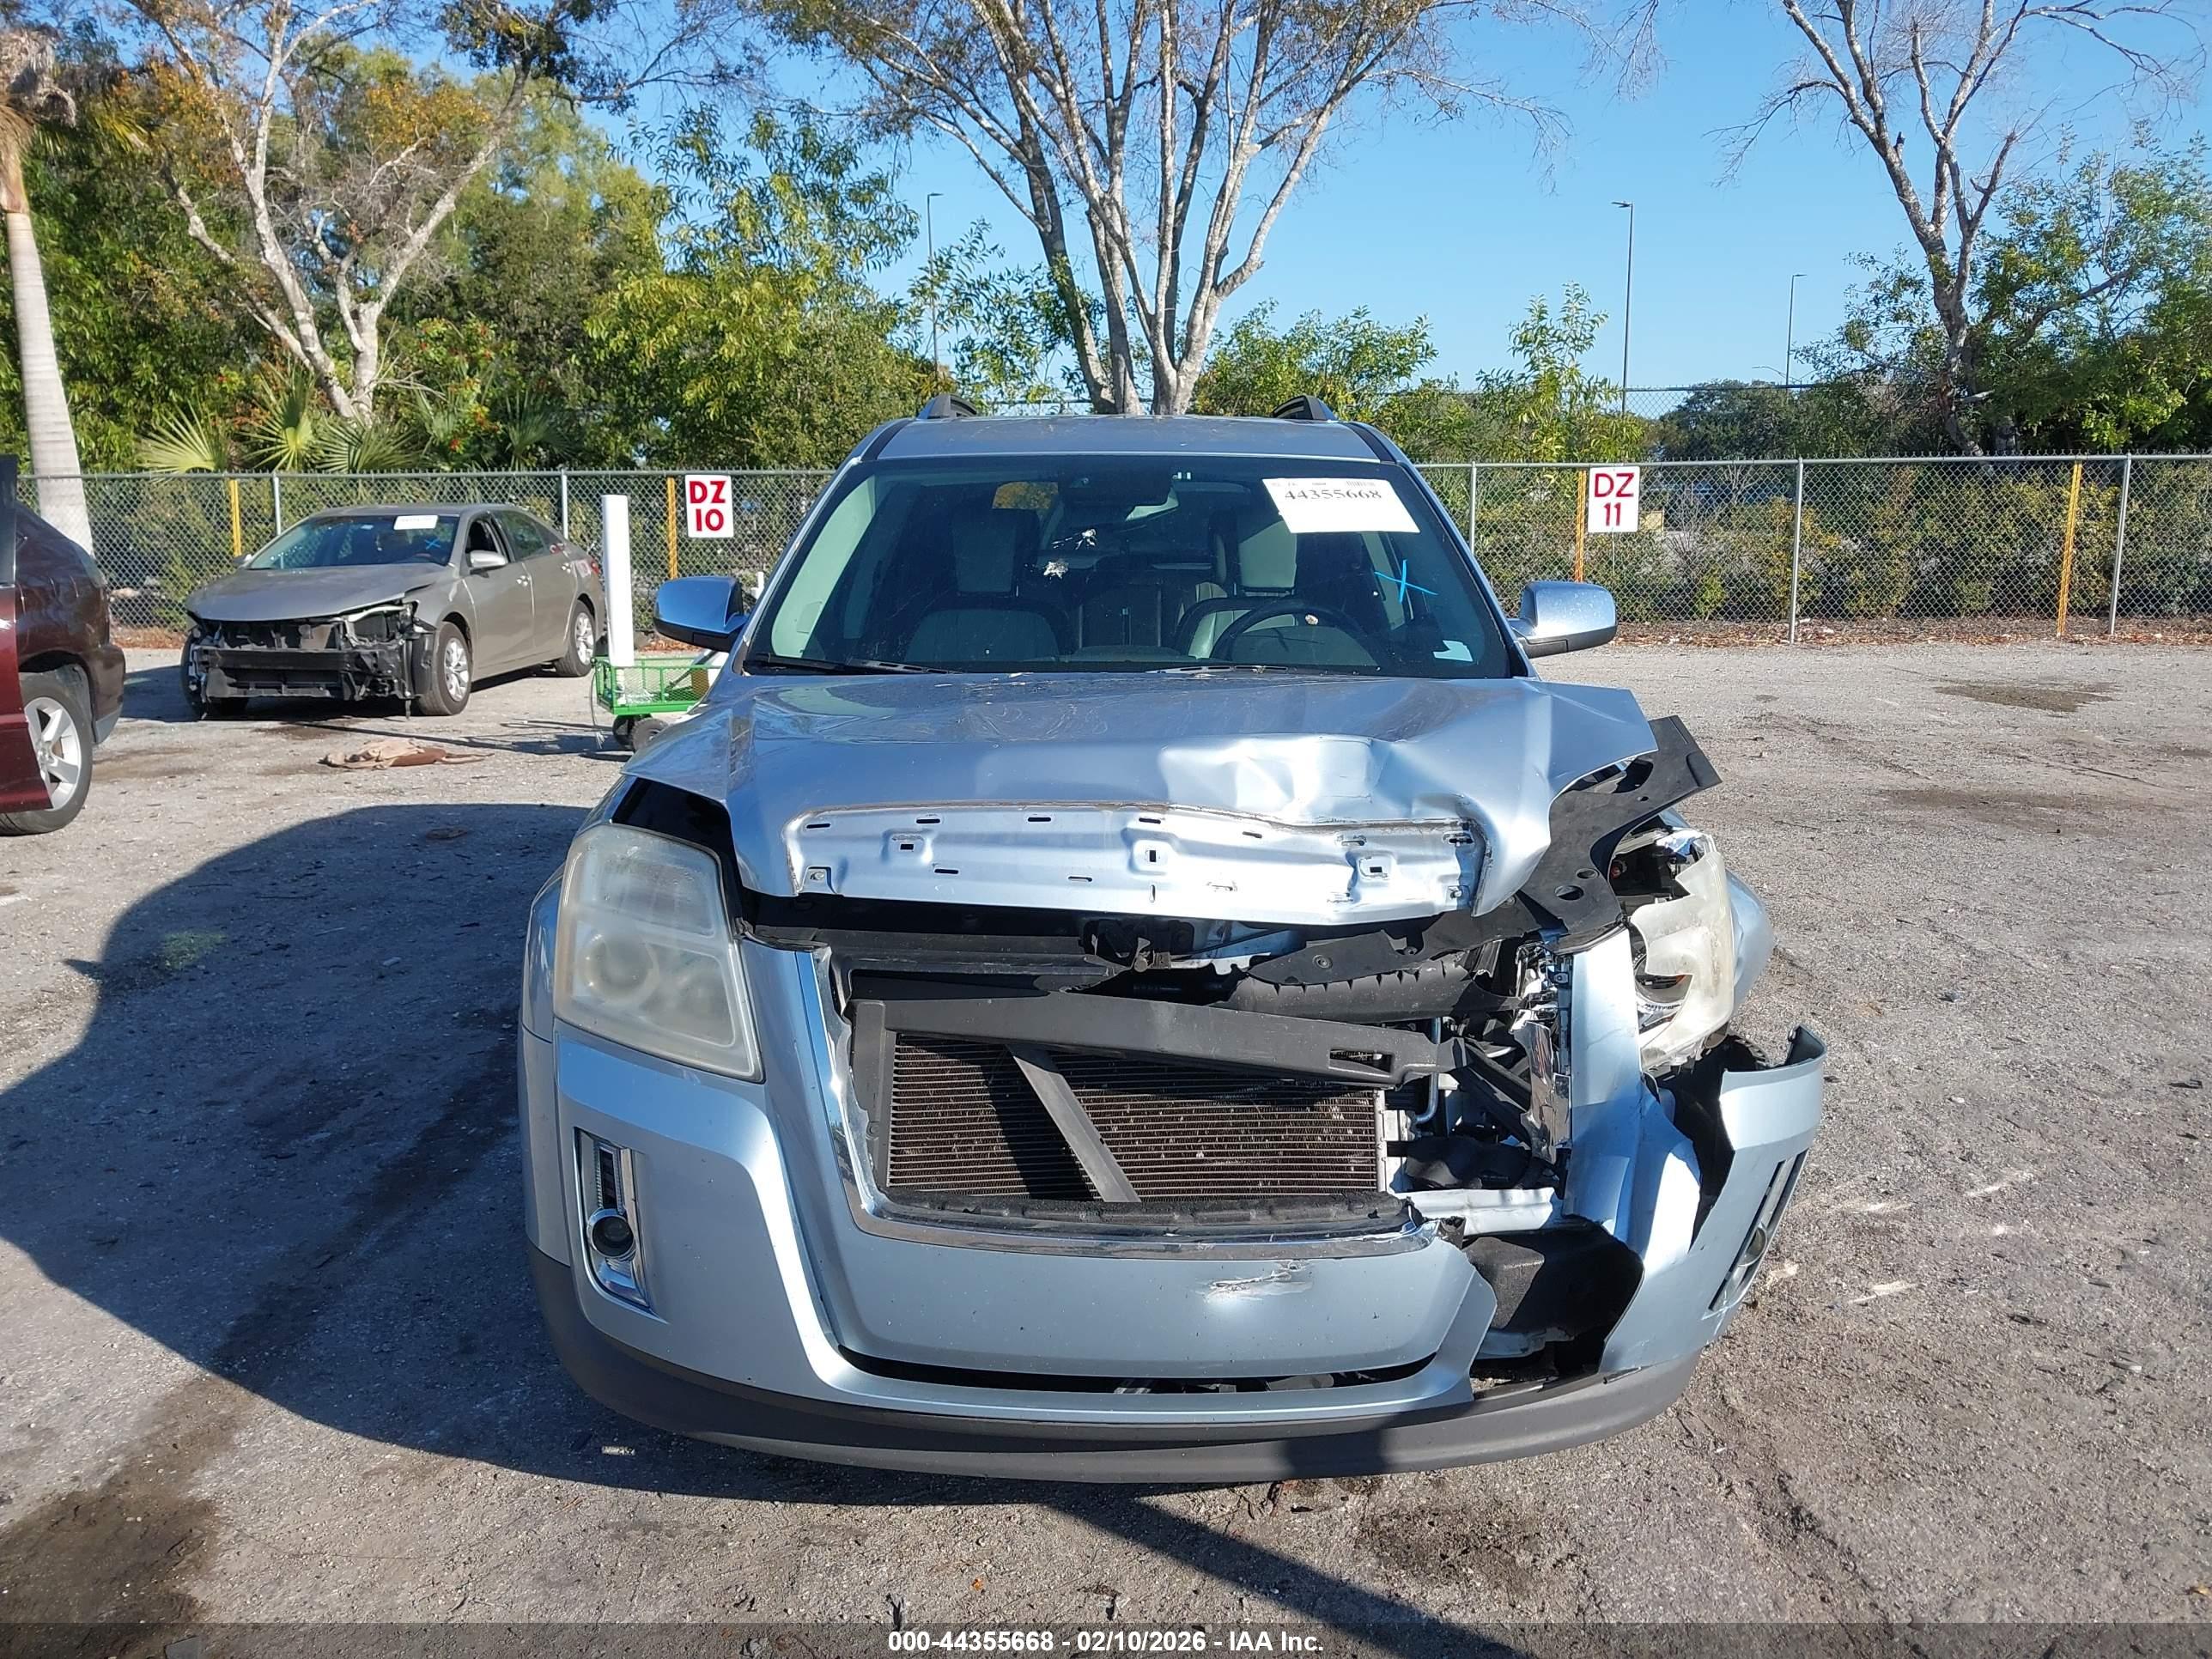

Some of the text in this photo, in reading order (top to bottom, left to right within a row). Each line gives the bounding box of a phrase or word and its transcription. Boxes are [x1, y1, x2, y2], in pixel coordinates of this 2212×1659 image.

[689, 480, 726, 504] DZ
[1285, 489, 1382, 500] 44355668
[1594, 472, 1635, 498] DZ
[1603, 502, 1622, 526] 11
